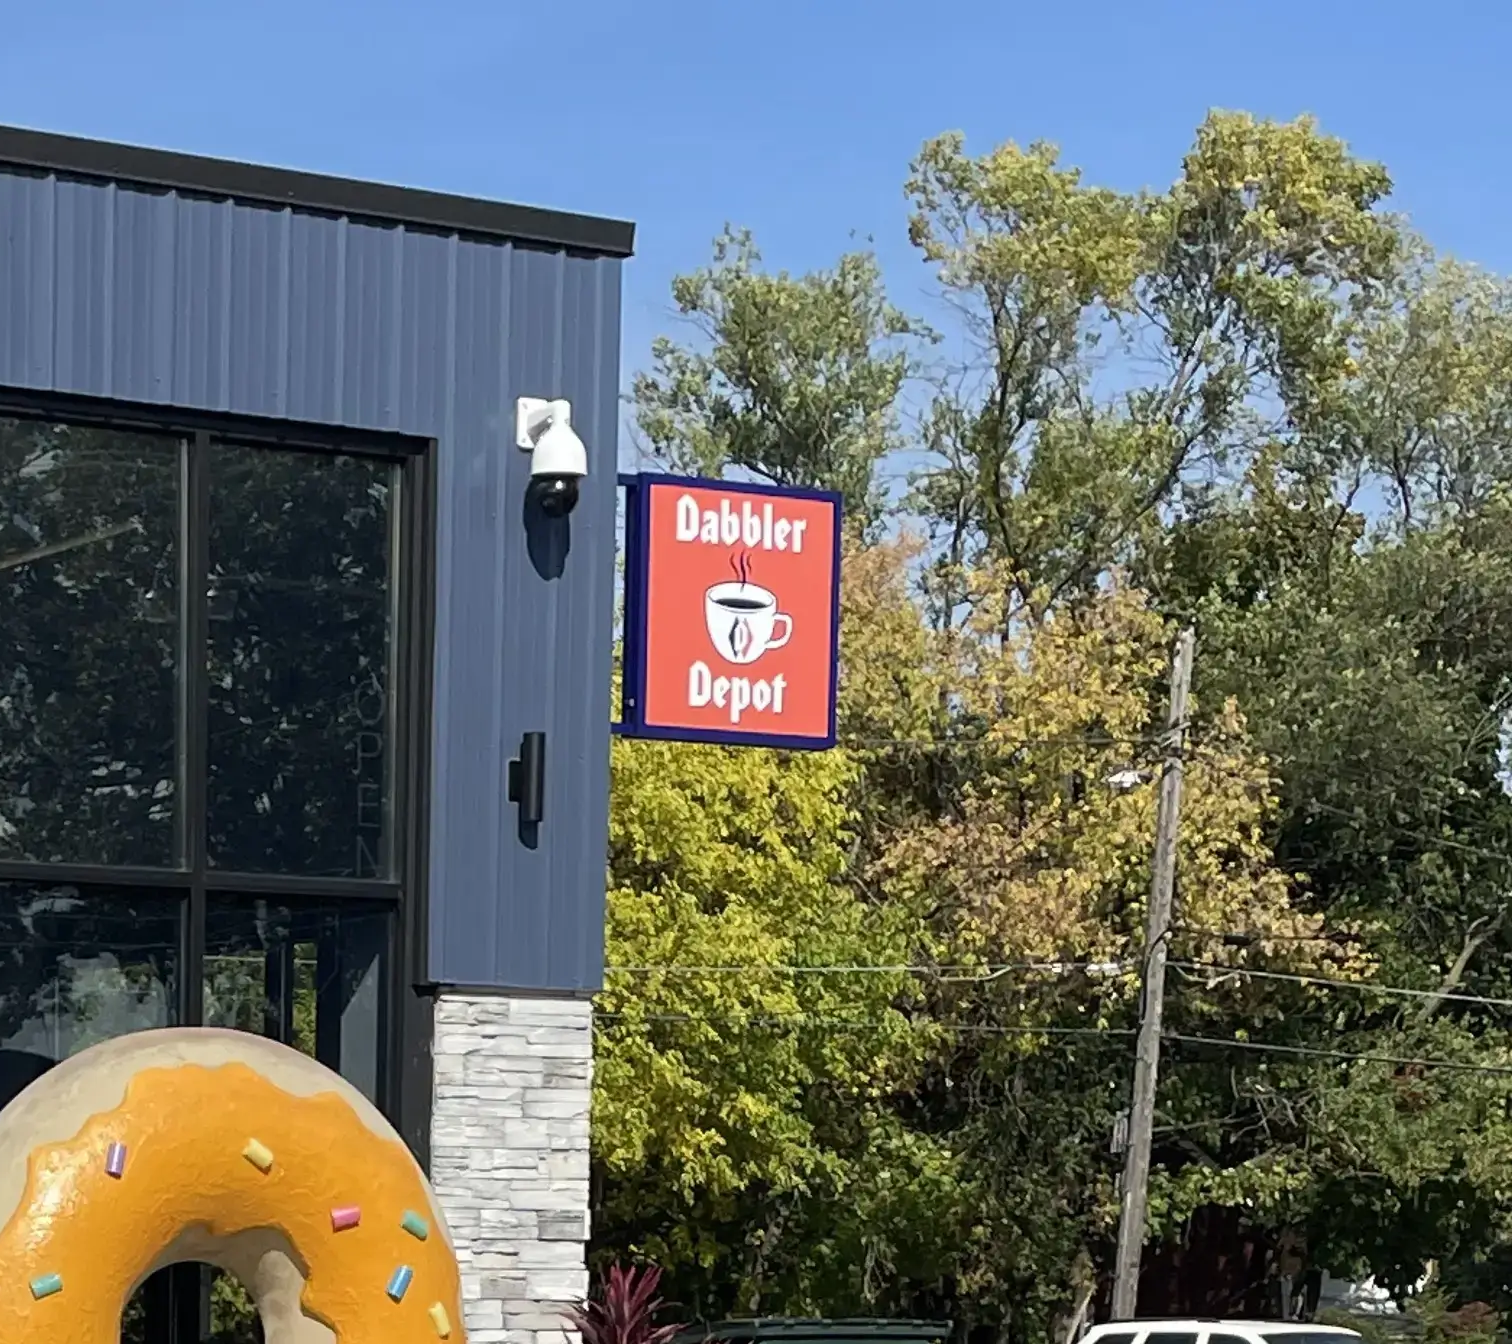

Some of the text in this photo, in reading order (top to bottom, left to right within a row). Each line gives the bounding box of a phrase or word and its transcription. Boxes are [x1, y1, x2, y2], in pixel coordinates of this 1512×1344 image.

[676, 494, 807, 553] Dabbler
[688, 660, 787, 725] Depot
[353, 679, 386, 878] OPEN
